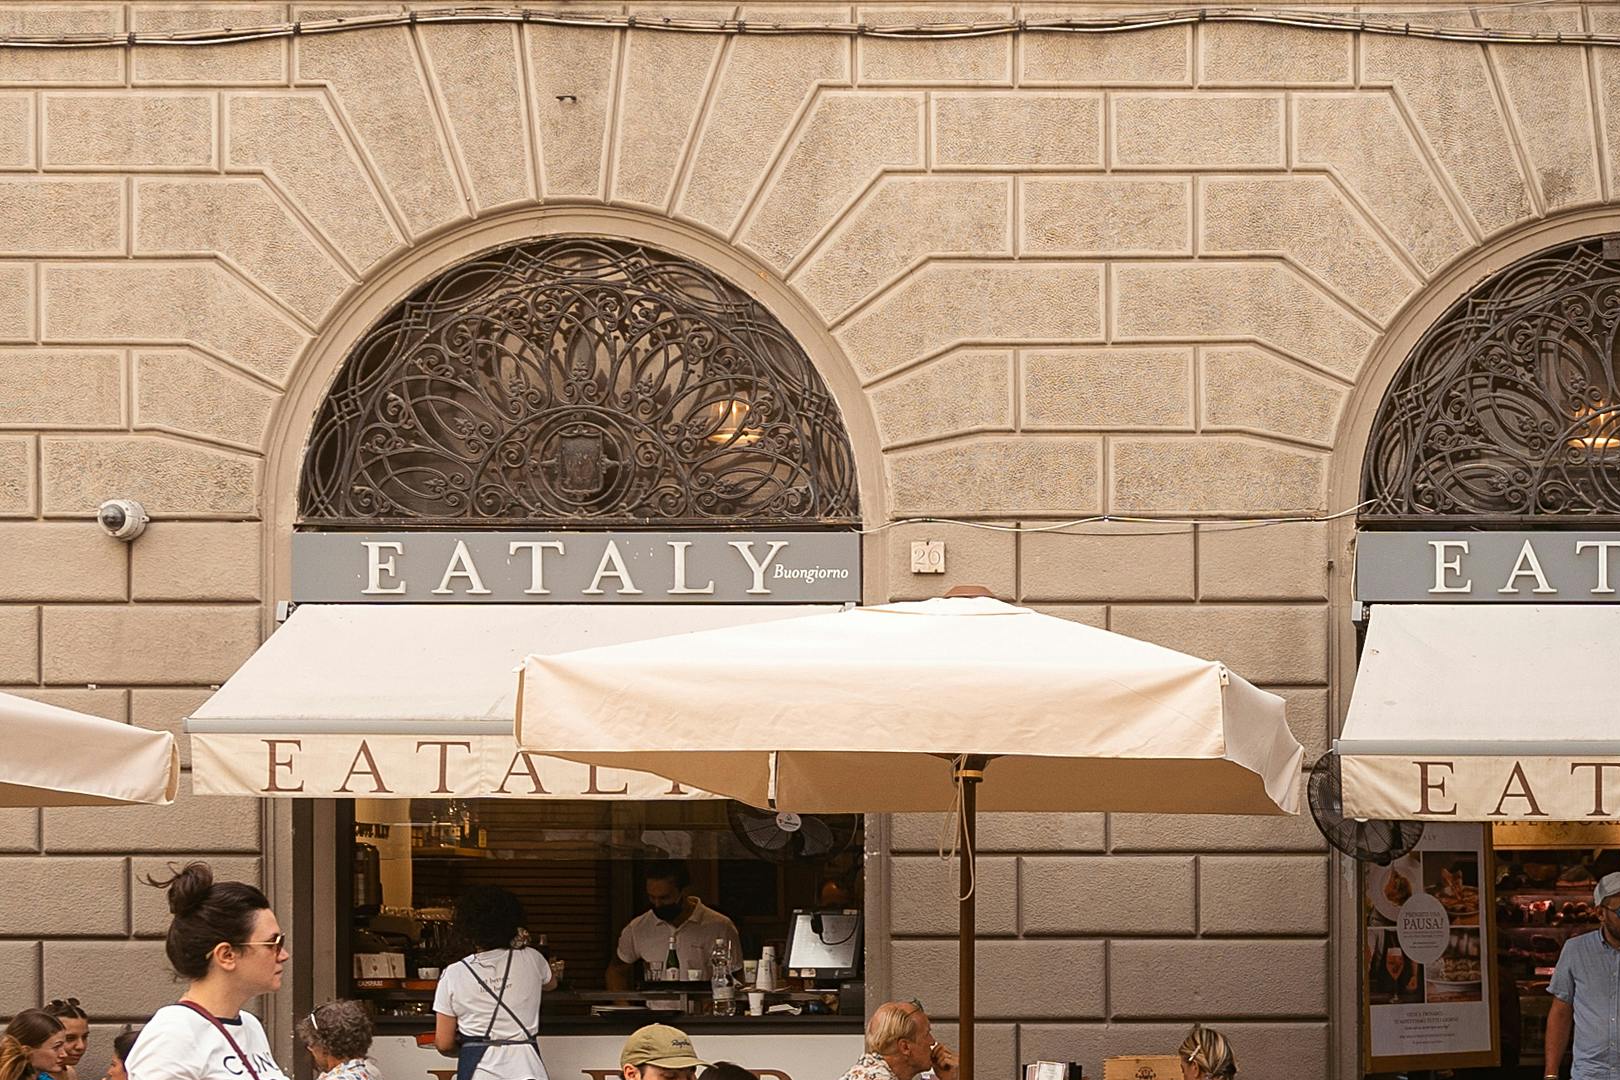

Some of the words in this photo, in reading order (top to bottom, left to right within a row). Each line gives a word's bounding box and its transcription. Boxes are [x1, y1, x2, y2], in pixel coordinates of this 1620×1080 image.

[361, 540, 789, 596] EATALY
[773, 563, 849, 583] Buongiorno
[260, 739, 688, 796] EATAL
[1403, 918, 1444, 931] PAUSA!
